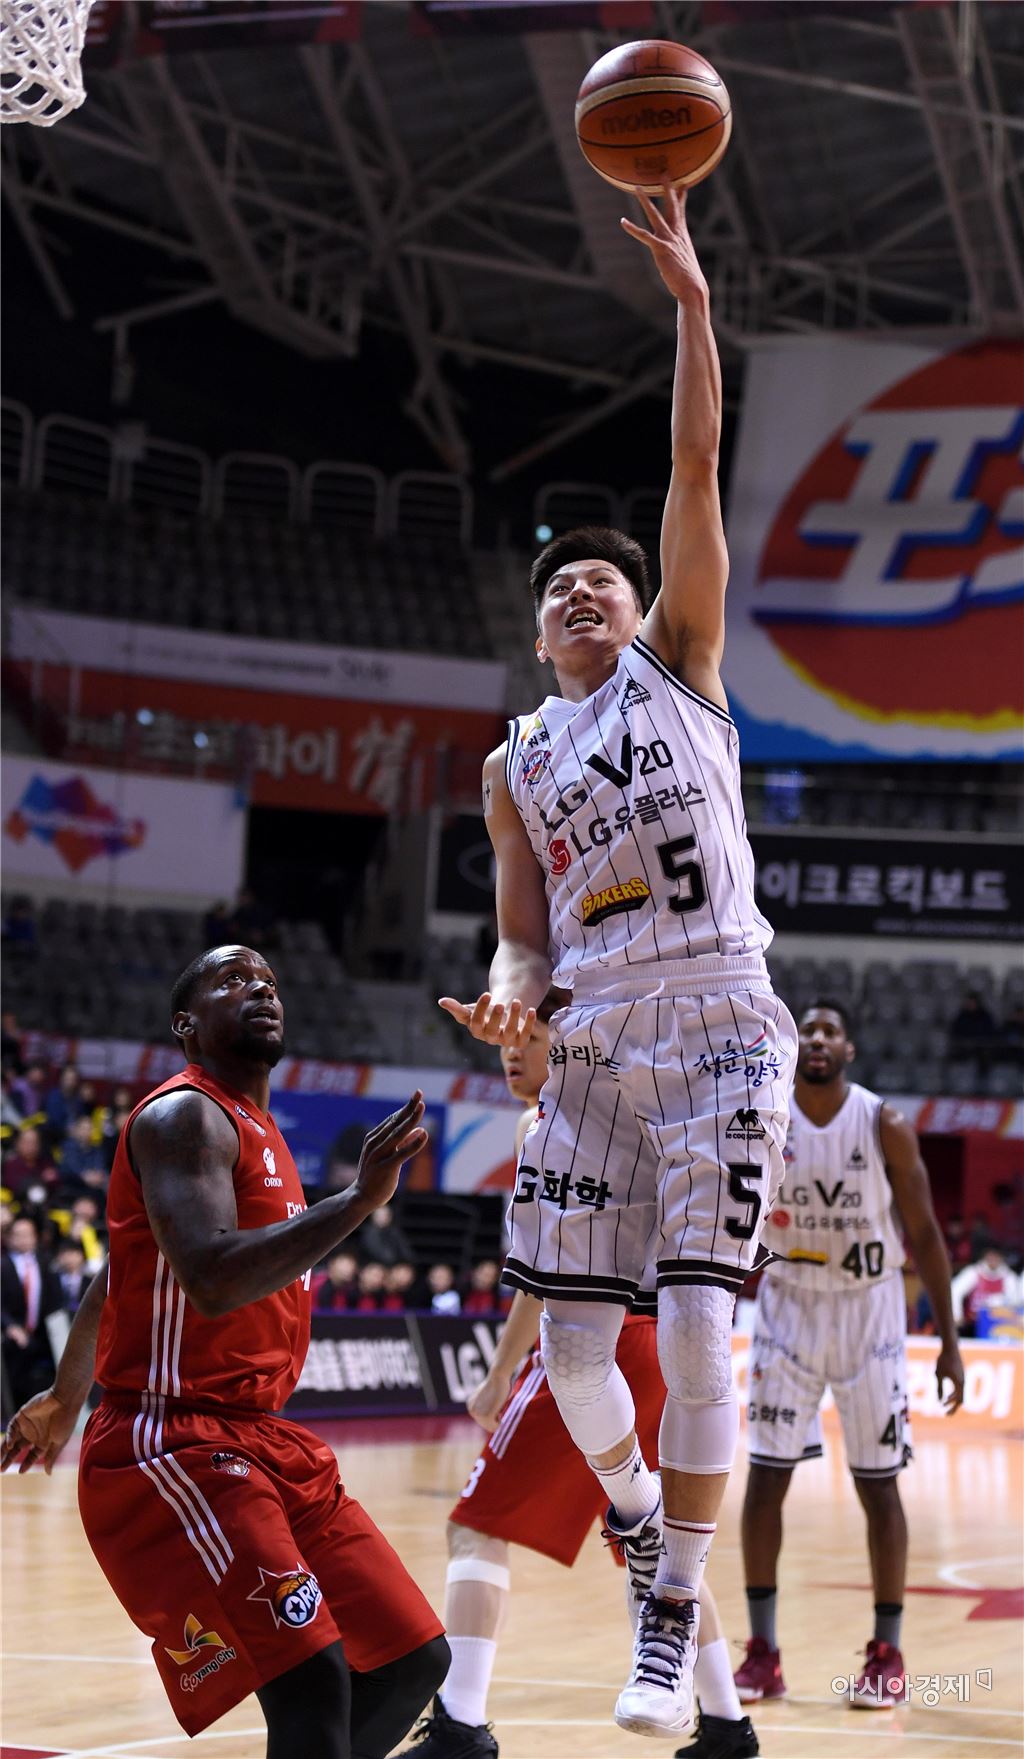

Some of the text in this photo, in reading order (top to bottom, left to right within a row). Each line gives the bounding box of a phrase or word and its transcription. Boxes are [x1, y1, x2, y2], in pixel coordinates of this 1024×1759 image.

[601, 105, 692, 135] molten
[752, 407, 1024, 624] 포
[539, 780, 590, 833] LG
[570, 781, 706, 857] LG유플러스
[655, 832, 709, 917] 5
[756, 860, 1010, 912] 이크로킥보드
[581, 877, 651, 921] SAKERS
[724, 1162, 764, 1241] 5
[779, 1184, 809, 1206] LG
[841, 1241, 885, 1279] 40
[460, 1458, 486, 1498] 3
[180, 1647, 237, 1692] Goyang City
